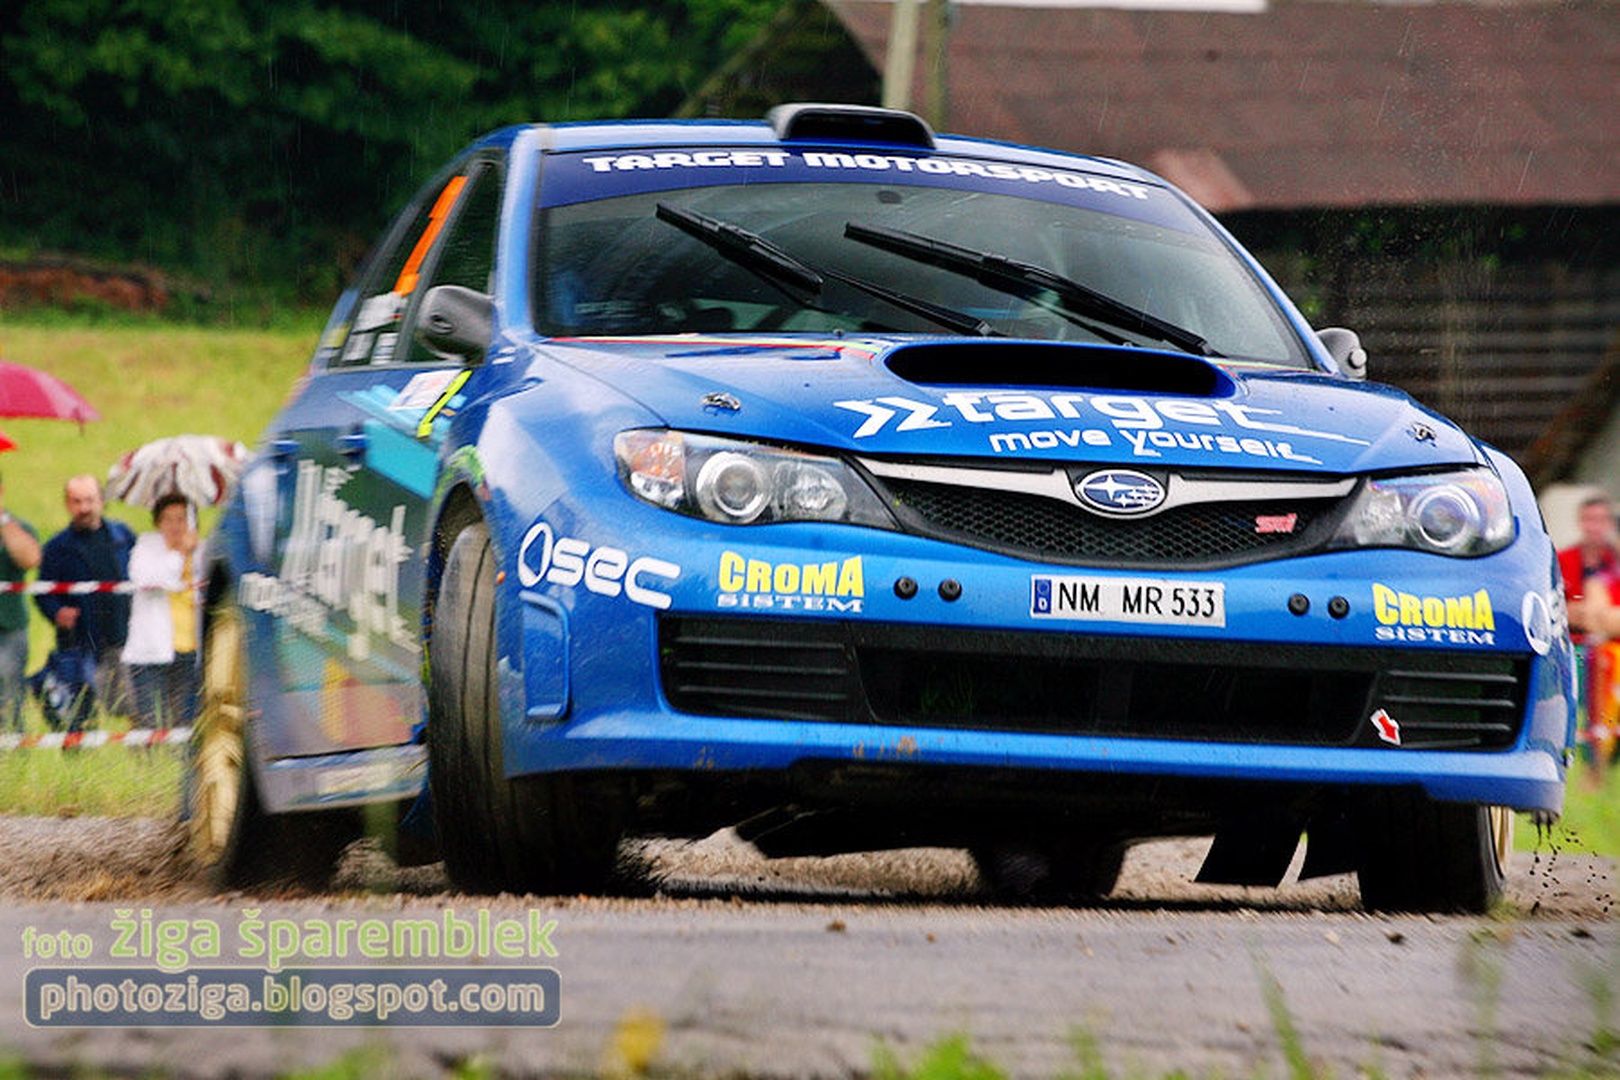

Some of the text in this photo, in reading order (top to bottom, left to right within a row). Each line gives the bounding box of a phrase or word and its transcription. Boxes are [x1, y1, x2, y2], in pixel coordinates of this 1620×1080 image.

[583, 152, 1150, 201] TARGET MOTORSPORT
[942, 391, 1371, 446] target
[988, 428, 1324, 465] move yourself
[718, 550, 865, 598] CROMA
[716, 593, 865, 614] SISTEM
[1058, 581, 1216, 619] NM MR 533
[1372, 582, 1496, 631] CROMA
[1374, 626, 1496, 645] SISTEM
